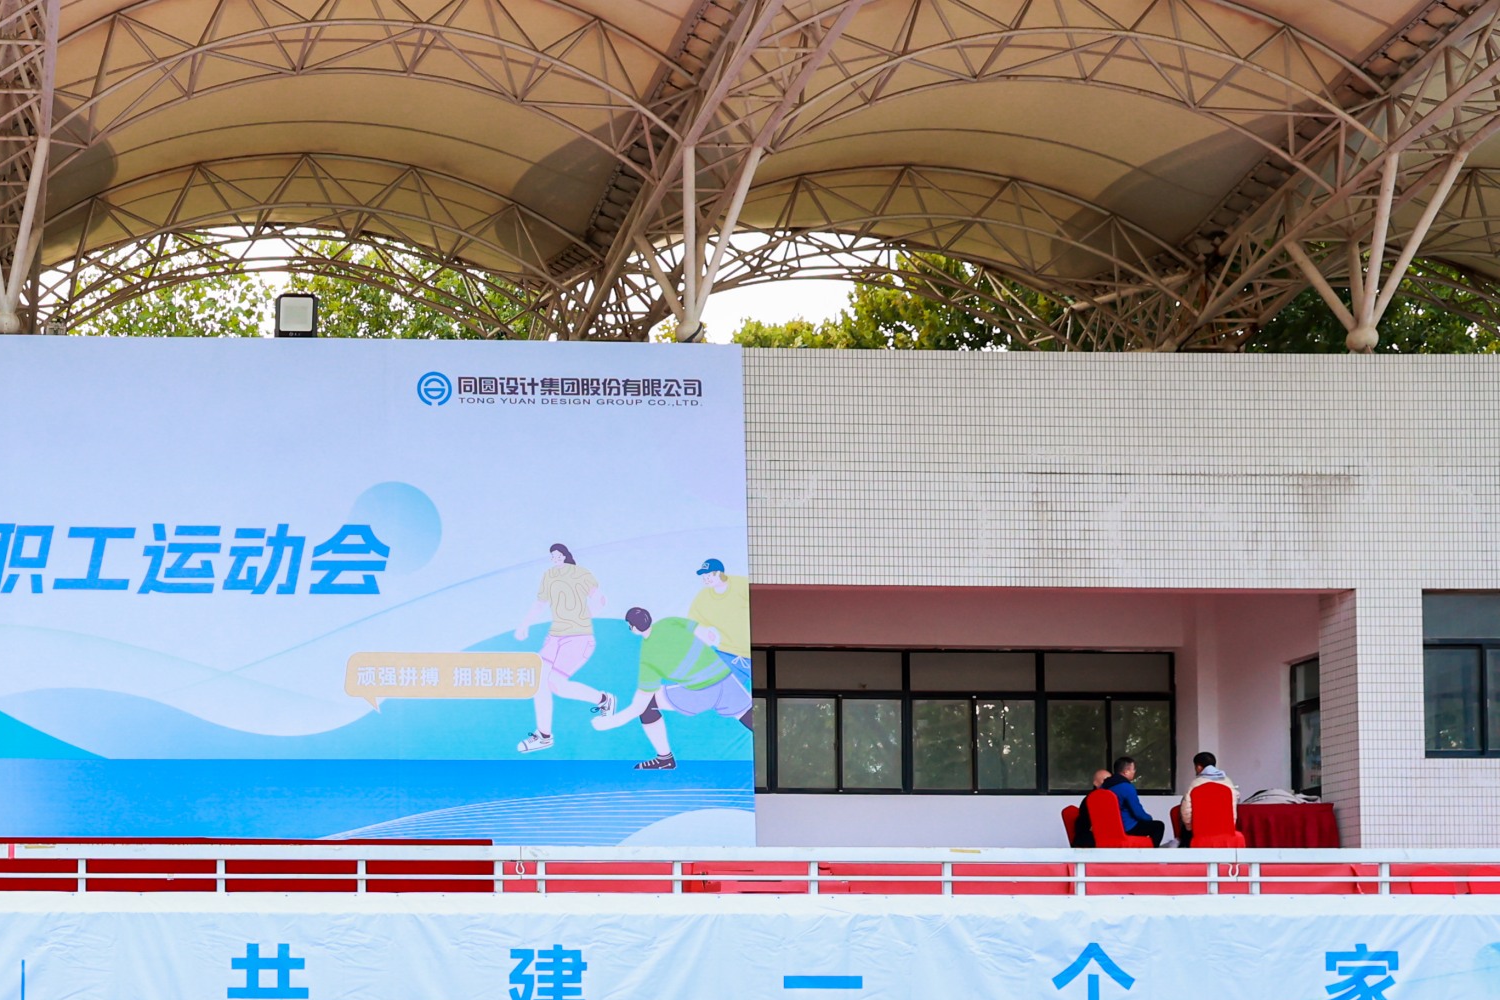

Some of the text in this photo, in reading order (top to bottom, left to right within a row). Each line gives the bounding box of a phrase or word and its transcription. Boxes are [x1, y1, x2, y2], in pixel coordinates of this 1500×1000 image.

[457, 376, 703, 397] 同圆设计集团股份有限公司
[458, 397, 495, 405] TONG
[500, 397, 536, 405] YUAN
[541, 398, 591, 406] DESIGN
[647, 399, 703, 407] CO.,LTD.
[356, 666, 536, 688] 顽强拼搏 拥抱胜利
